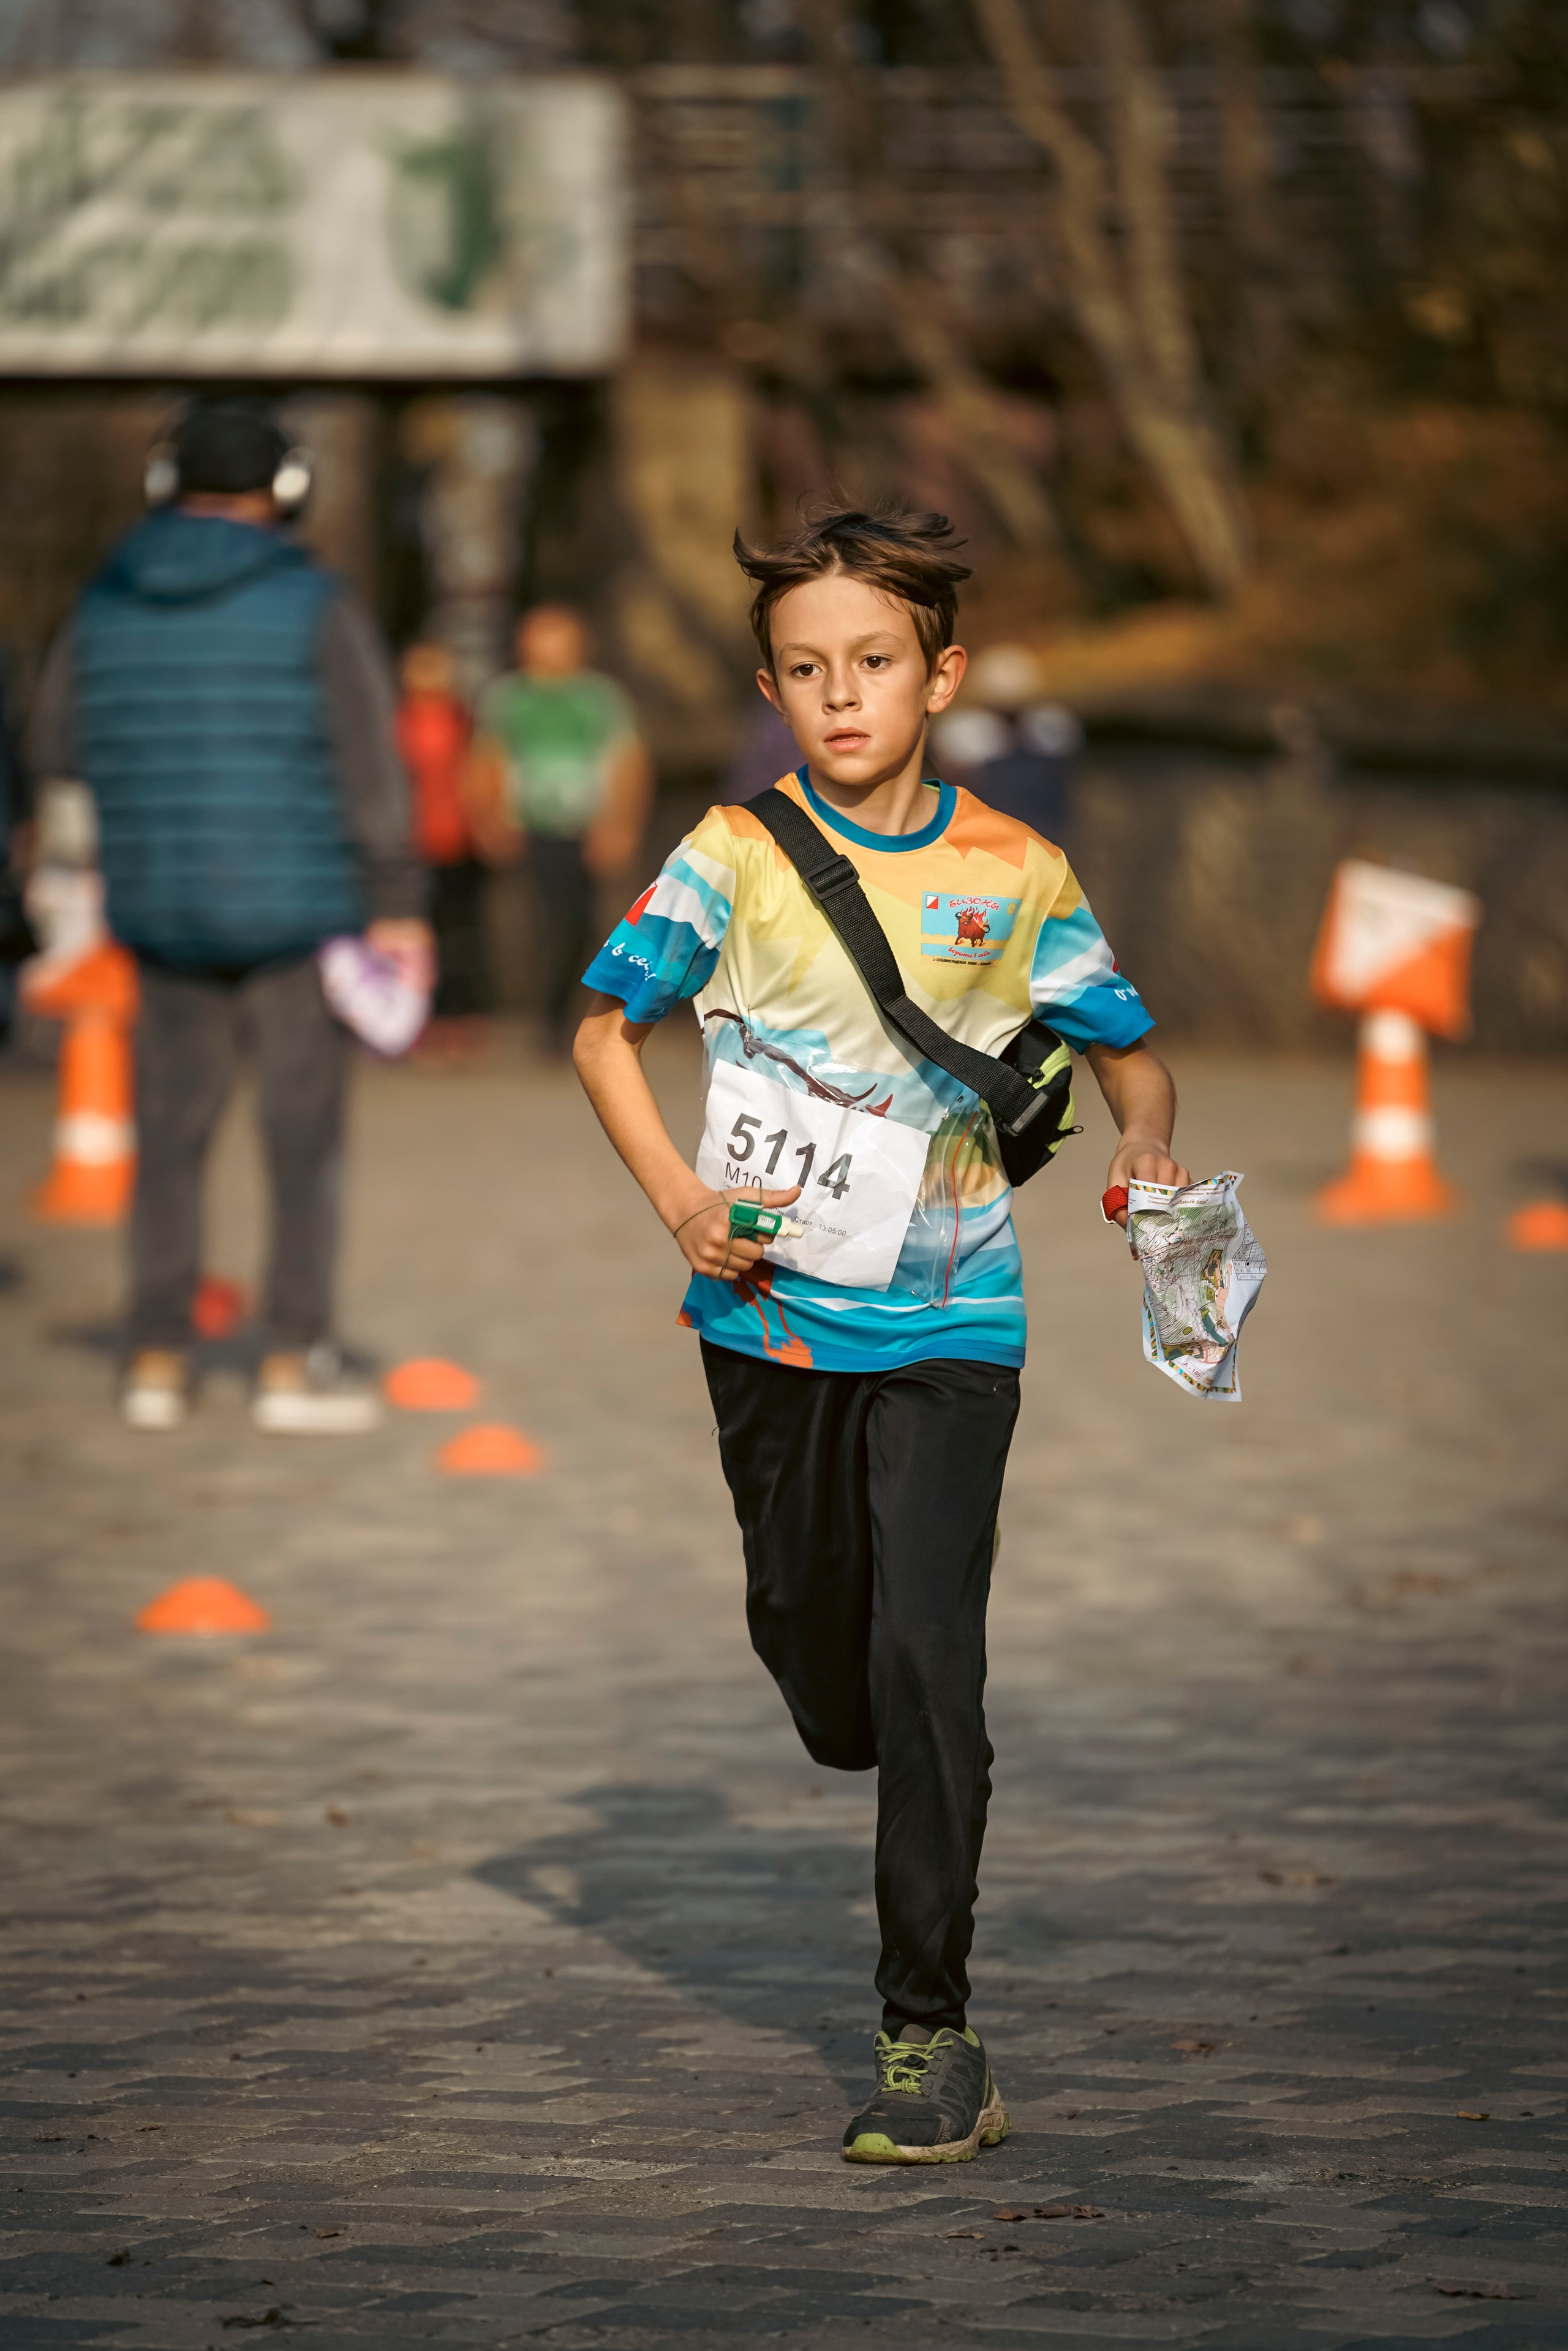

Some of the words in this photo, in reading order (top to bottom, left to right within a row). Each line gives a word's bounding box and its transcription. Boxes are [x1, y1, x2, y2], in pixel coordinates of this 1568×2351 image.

[726, 1112, 853, 1201] 5114
[794, 1215, 813, 1226] Старт
[818, 1223, 847, 1237] 13:05:00
